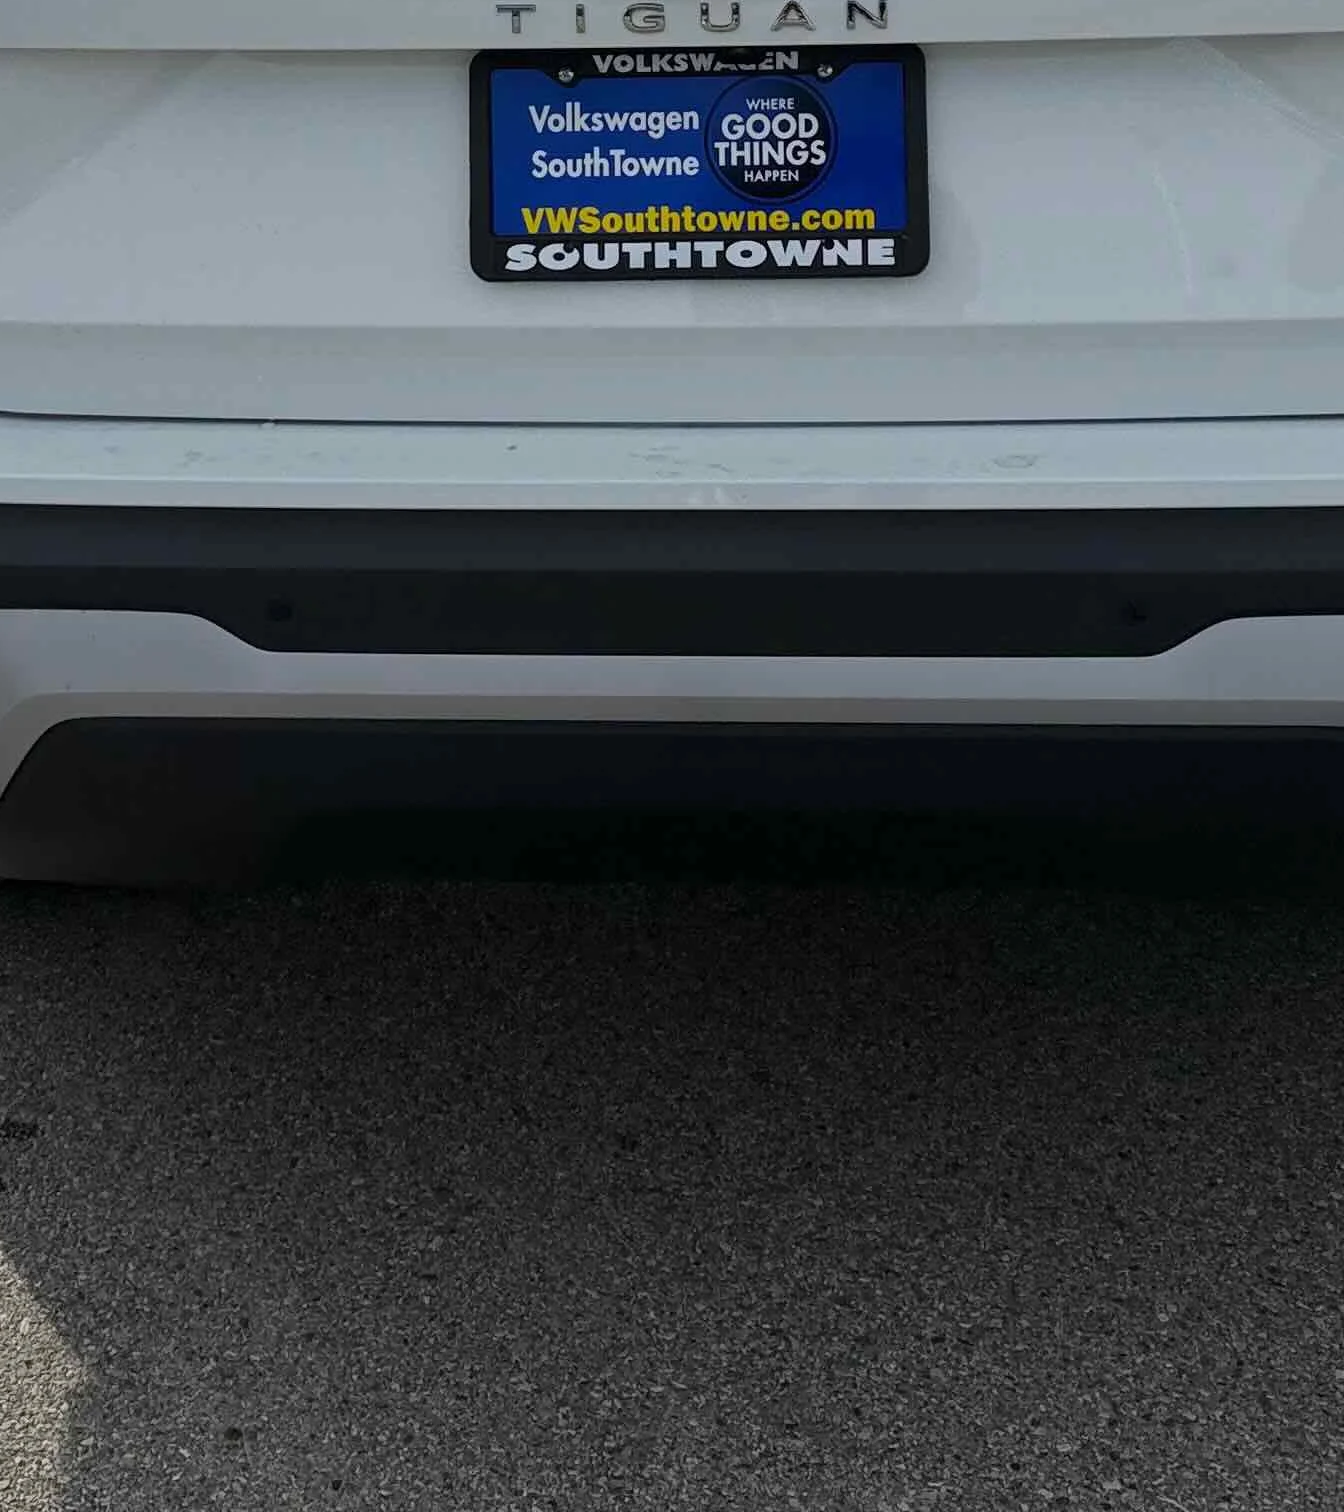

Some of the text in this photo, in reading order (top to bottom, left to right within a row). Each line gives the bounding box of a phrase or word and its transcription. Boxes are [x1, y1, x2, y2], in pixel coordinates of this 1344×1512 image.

[496, 0, 889, 34] TIGUAN
[746, 97, 795, 111] WHERE
[528, 101, 700, 140] Volkswagen
[721, 112, 820, 140] GOOD
[531, 146, 700, 179] SouthTowne
[713, 139, 827, 168] THINGS
[744, 169, 800, 184] HAPPEN
[521, 206, 876, 235] VWSouthtowne.com
[504, 238, 896, 272] SOUTHTOWNE
